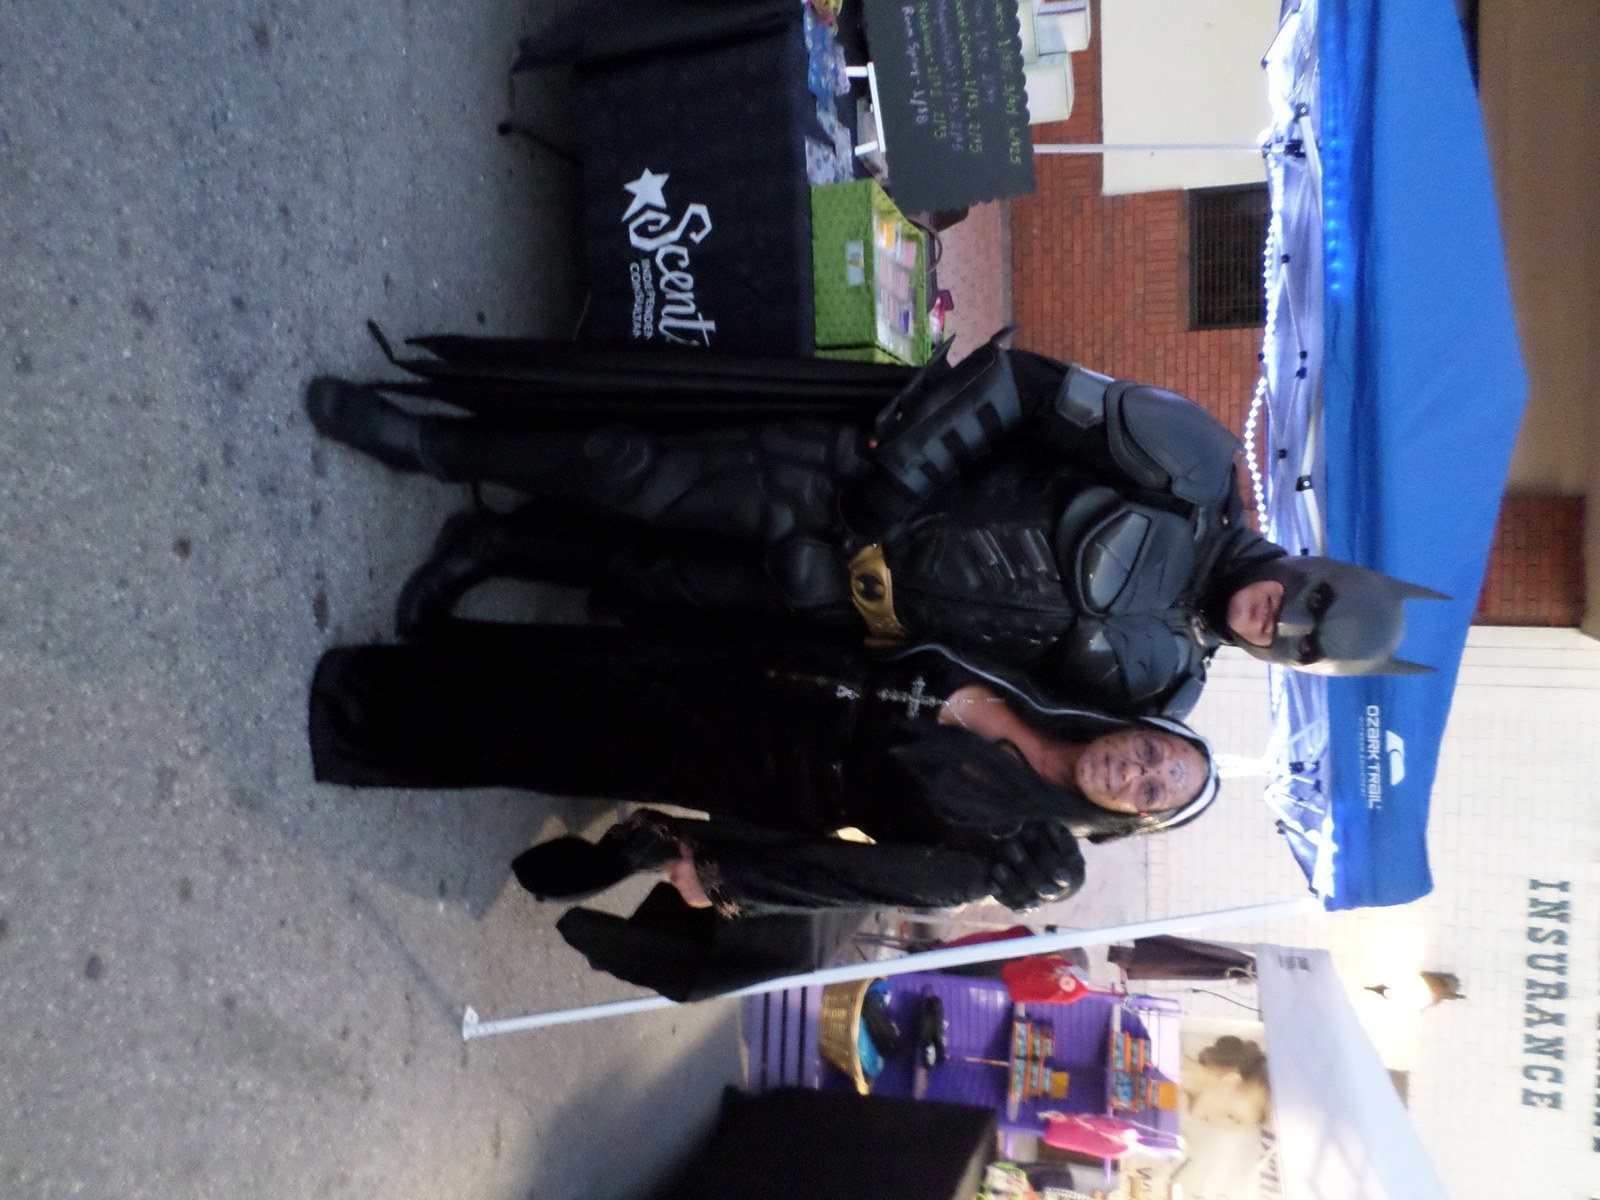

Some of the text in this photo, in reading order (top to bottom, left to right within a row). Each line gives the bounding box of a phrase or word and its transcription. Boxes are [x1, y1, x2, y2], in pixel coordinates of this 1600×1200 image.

[1366, 705, 1382, 809] OZARK TRAIL
[1522, 878, 1571, 1111] INSURANCE
